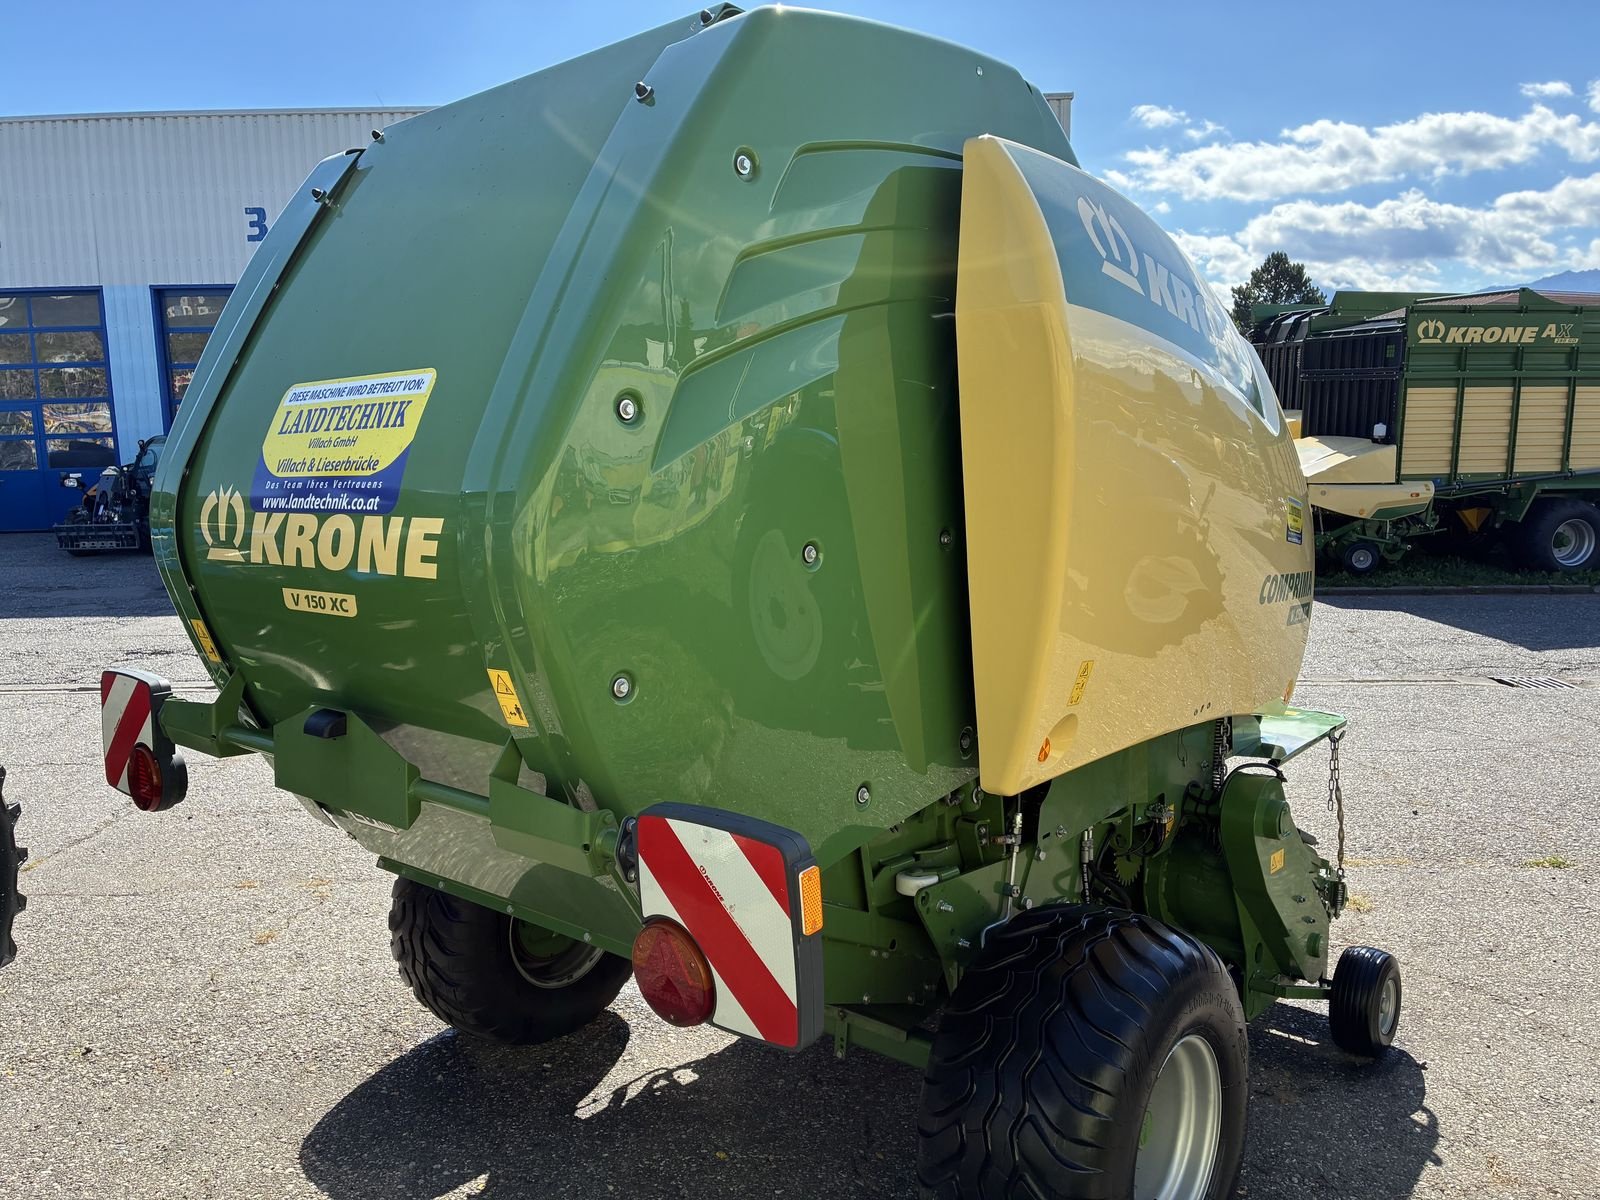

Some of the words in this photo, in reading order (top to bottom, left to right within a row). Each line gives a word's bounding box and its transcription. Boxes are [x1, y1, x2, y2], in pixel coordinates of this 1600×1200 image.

[245, 207, 268, 242] 3
[1445, 326, 1539, 344] KRONE
[288, 390, 309, 403] DIESE
[309, 386, 347, 401] MASCHINE
[346, 384, 368, 397] WIRD
[368, 381, 403, 394] BETREUT
[403, 379, 425, 391] VON:
[277, 400, 413, 436] LANDTECHNIK
[308, 438, 332, 449] Villach
[333, 436, 358, 448] GmbH
[276, 458, 306, 473] Villach
[307, 458, 316, 472] &
[316, 455, 380, 472] Lieserbrücke
[265, 481, 279, 489] Das
[283, 480, 303, 489] Team
[306, 479, 328, 489] Ihres
[333, 479, 383, 489] Vertrauens
[262, 493, 380, 511] www.landtechnik.co.at
[250, 512, 445, 580] KRONE
[291, 592, 300, 607] V
[304, 594, 326, 610] 150
[330, 598, 349, 613] XC
[704, 874, 725, 902] KRONE
